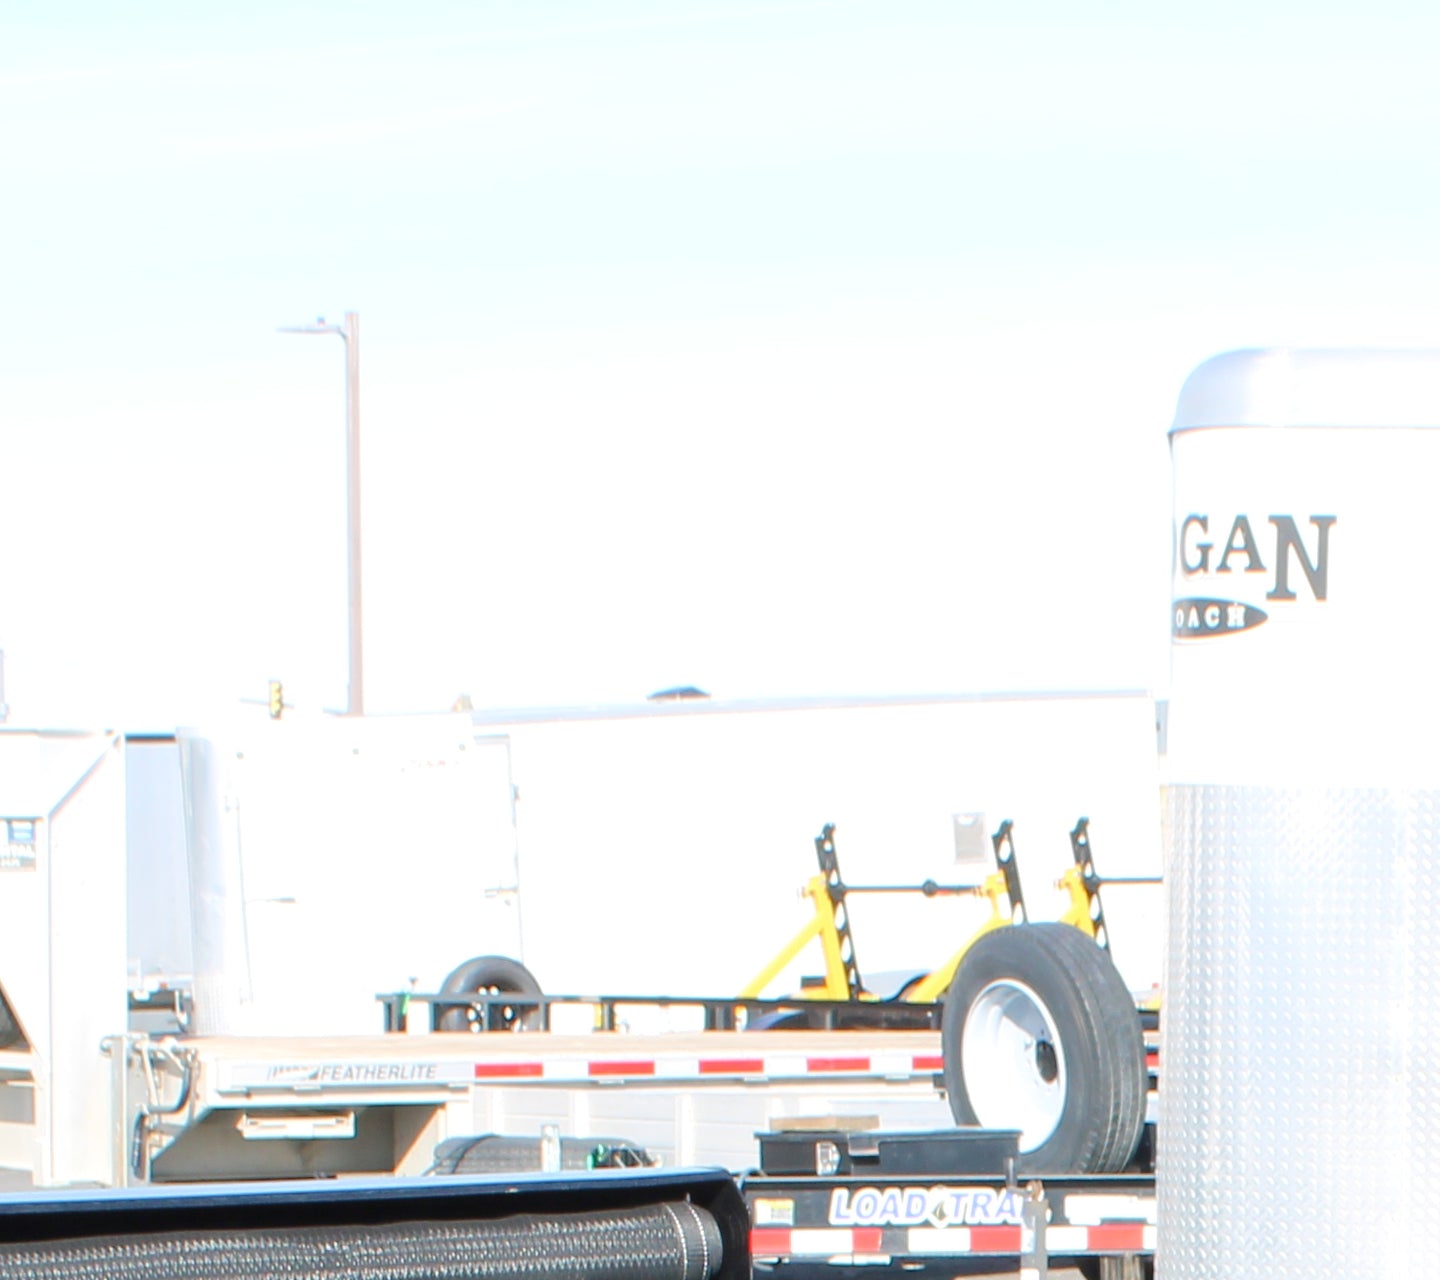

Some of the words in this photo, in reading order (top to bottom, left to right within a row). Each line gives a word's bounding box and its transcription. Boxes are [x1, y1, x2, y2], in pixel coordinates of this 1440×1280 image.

[1173, 512, 1338, 602] GAN
[320, 1063, 438, 1082] FEATHERLITE
[830, 1187, 929, 1225] LOAD
